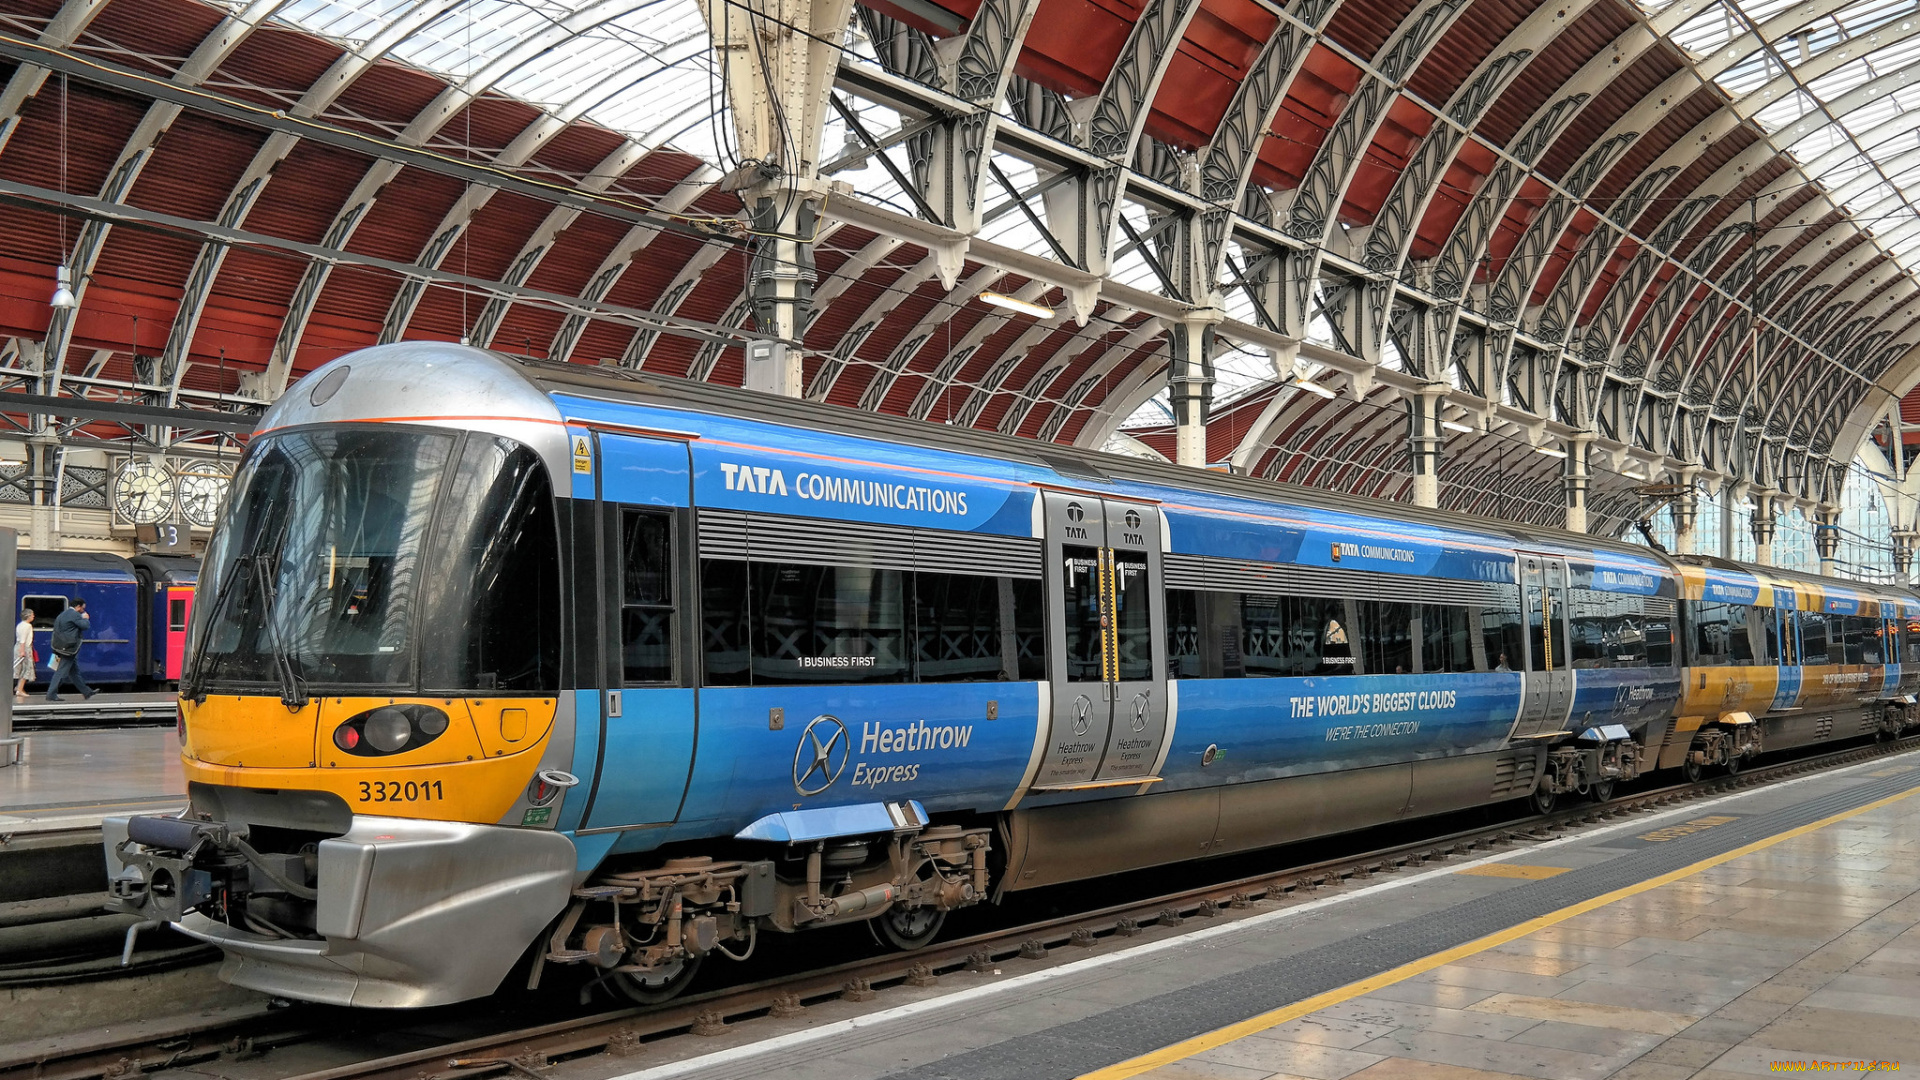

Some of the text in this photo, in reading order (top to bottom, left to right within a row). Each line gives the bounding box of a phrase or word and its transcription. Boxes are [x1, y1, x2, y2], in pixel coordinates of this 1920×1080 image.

[720, 462, 968, 516] TATA COMMUNICATIONS
[169, 526, 178, 546] 3
[1065, 526, 1088, 539] TATA
[1124, 533, 1144, 545] TATA
[1340, 543, 1415, 562] TATA COMMUNICATIONS
[1065, 558, 1075, 588] 1
[1116, 562, 1146, 591] 1 BUSINESS
[798, 656, 876, 667] 1 BUSINESS FIRST
[1290, 690, 1456, 718] THE WORLD'S BIGGEST CLOUDS
[860, 720, 973, 754] Heathrow
[1325, 721, 1420, 742] WE'RE THE CONNECTION
[1057, 741, 1096, 754] Heathrow
[1116, 738, 1152, 750] Heathrow
[1061, 756, 1084, 767] Express
[1120, 752, 1141, 762] Express
[851, 762, 920, 789] Express
[359, 780, 443, 802] 332011
